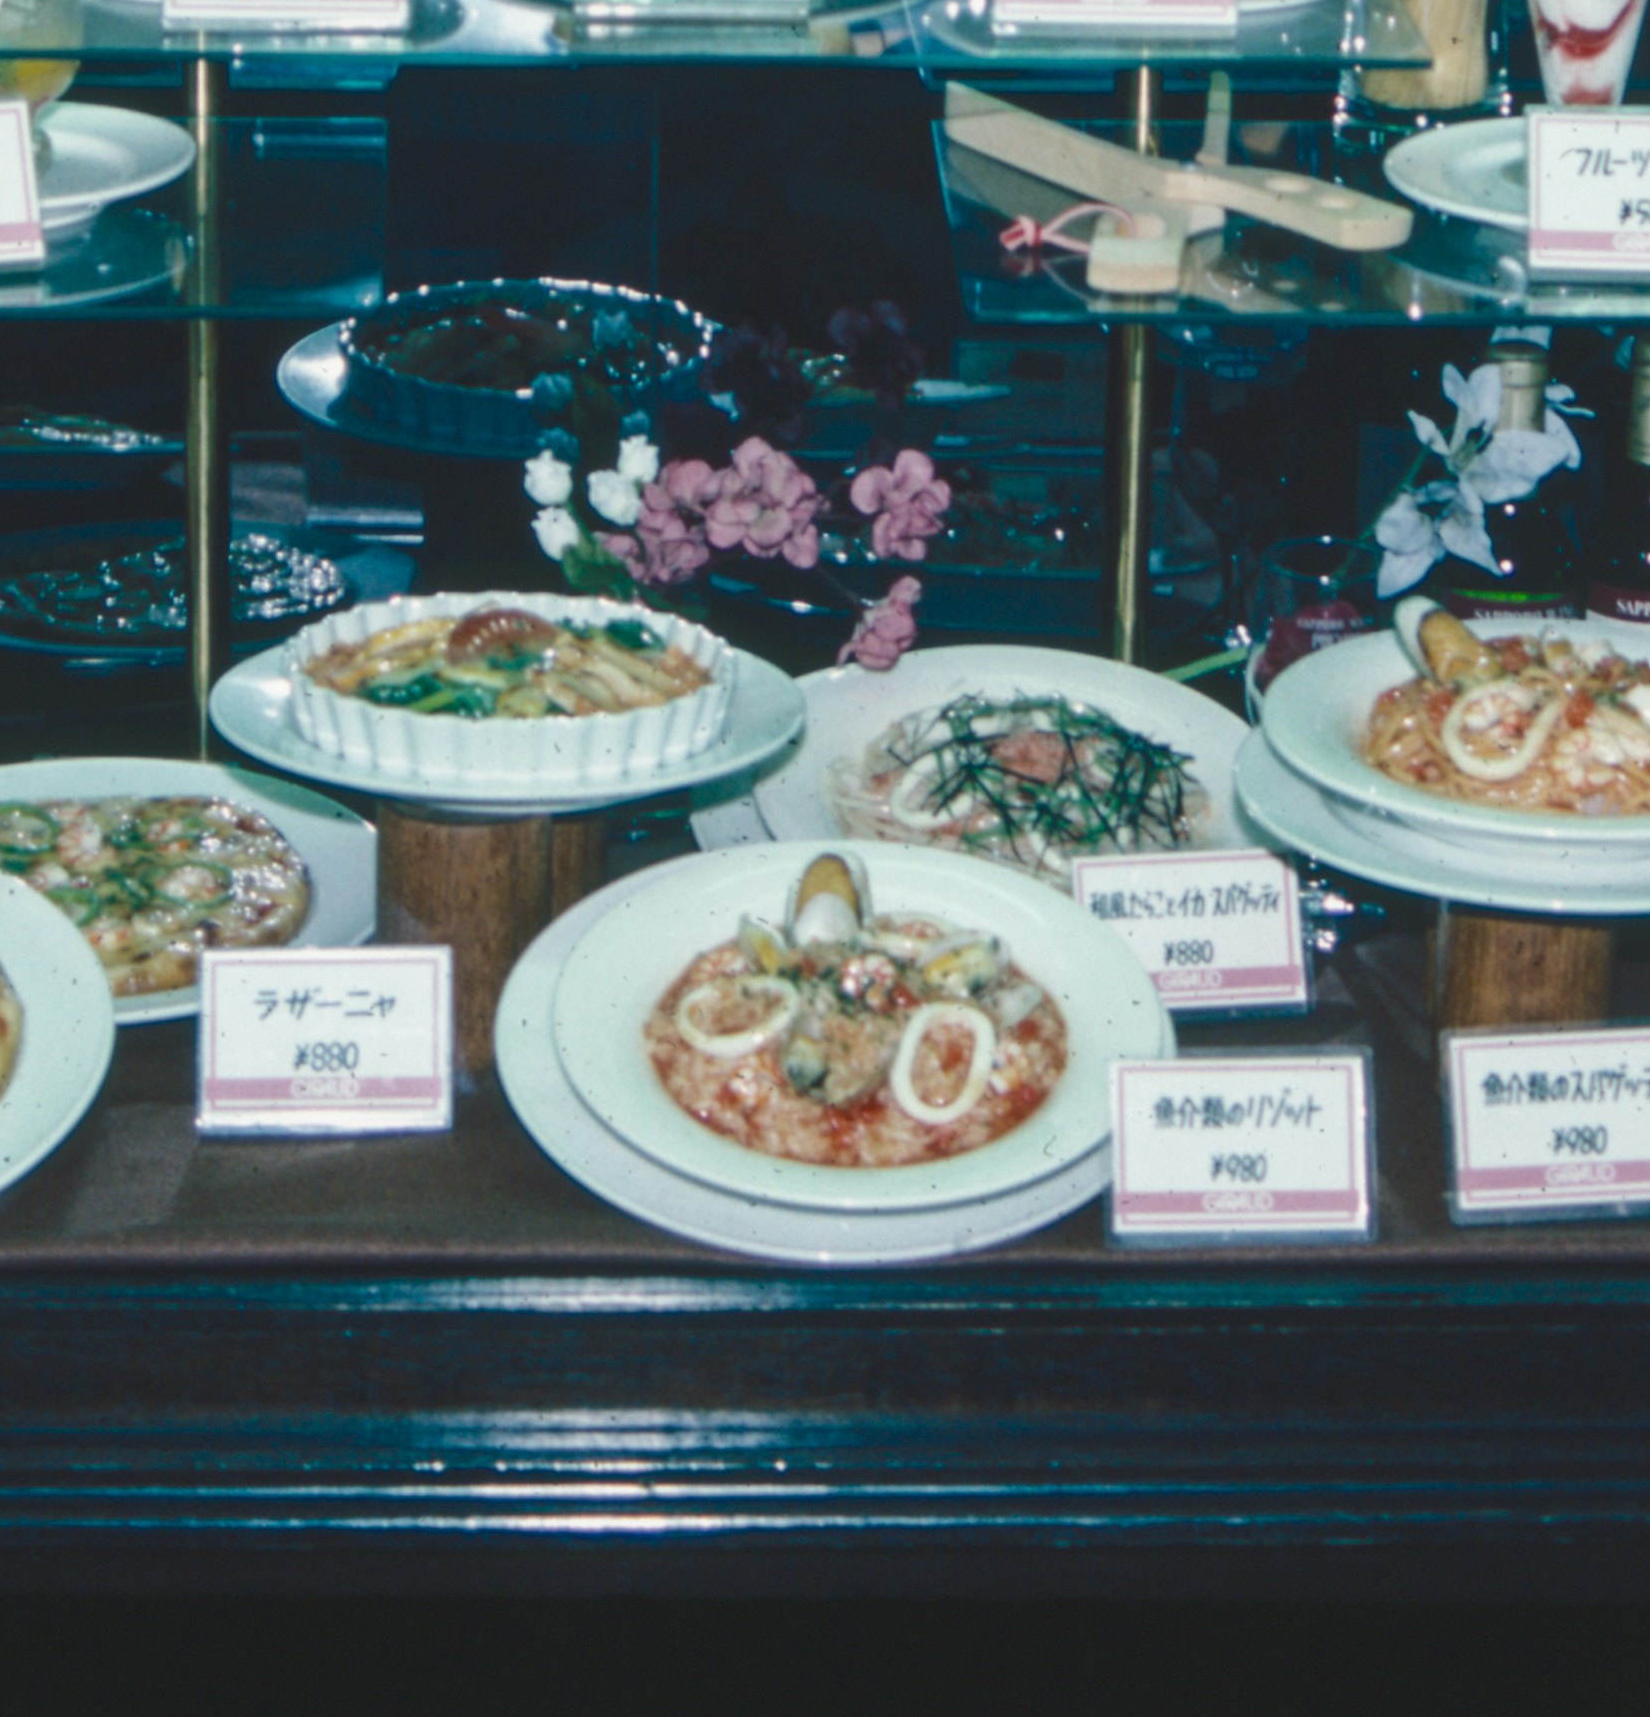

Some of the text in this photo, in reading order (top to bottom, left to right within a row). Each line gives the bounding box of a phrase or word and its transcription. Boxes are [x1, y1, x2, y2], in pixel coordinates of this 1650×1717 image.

[1163, 940, 1215, 967] ¥880
[253, 986, 397, 1022] ラザーニャ
[293, 1041, 361, 1073] ¥880
[1551, 1125, 1609, 1157] ¥980
[1210, 1153, 1269, 1183] ¥980
